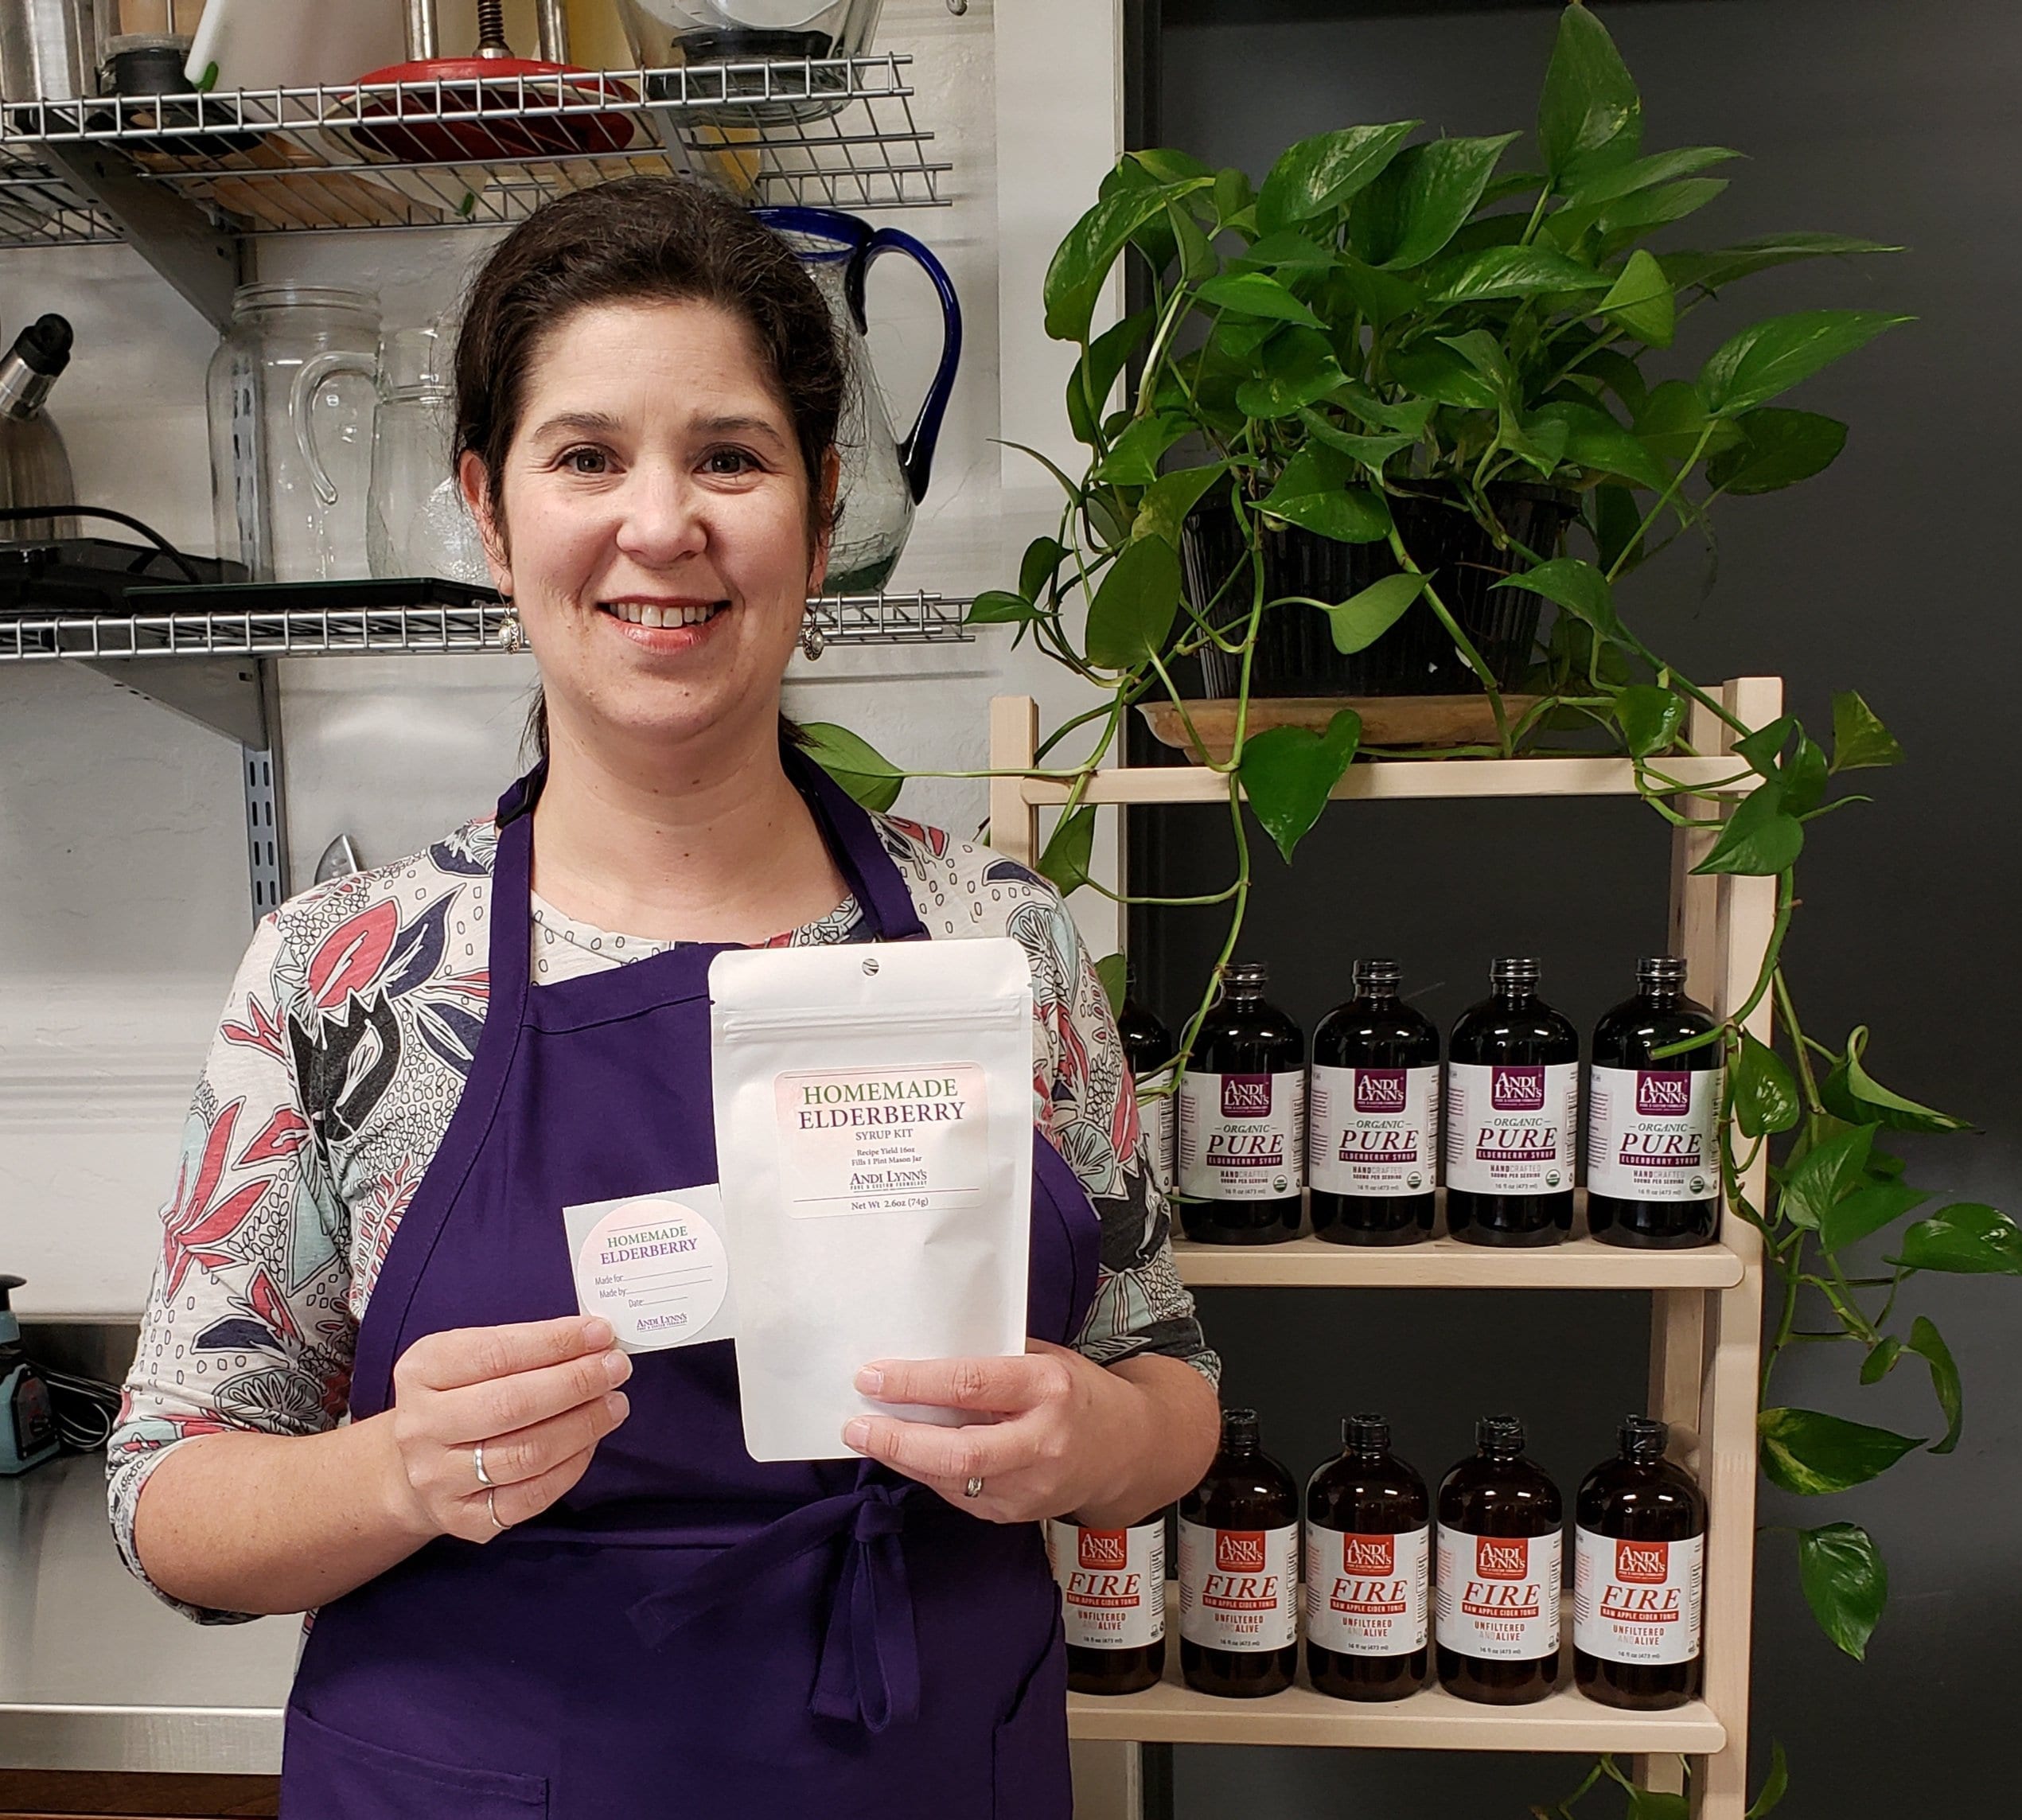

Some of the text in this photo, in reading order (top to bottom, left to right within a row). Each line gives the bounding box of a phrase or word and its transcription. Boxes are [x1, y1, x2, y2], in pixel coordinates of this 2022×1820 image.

[1226, 1080, 1264, 1095] ANDI
[1359, 1075, 1398, 1090] ANDI
[1498, 1072, 1537, 1088] ANDI
[1642, 1077, 1682, 1093] ANDI
[802, 1078, 958, 1105] HOMEMADE
[798, 1101, 965, 1130] ELDERBERRY
[855, 1128, 914, 1141] SYRUP KIT
[1223, 1124, 1270, 1133] ORGANIC
[1638, 1123, 1688, 1132] ORGANIC
[1206, 1134, 1284, 1154] PURE
[1338, 1130, 1419, 1150] PURE
[1476, 1128, 1557, 1148] PURE
[1619, 1133, 1703, 1153] PURE
[857, 1148, 879, 1157] Recipe
[881, 1147, 898, 1156] Yield
[889, 1156, 910, 1164] Mason
[1622, 1156, 1671, 1164] ELDERBERRY
[849, 1172, 883, 1186] ANDI
[851, 1197, 929, 1210] Net Wt 2.6oz (74g)
[607, 1226, 688, 1248] HOMEMADE
[600, 1238, 698, 1265] ELDERBERRY
[595, 1275, 613, 1285] Made
[599, 1289, 617, 1299] Made
[637, 1318, 659, 1327] ANDI
[1082, 1534, 1119, 1549] ANDI
[1221, 1535, 1256, 1551] ANDI
[1349, 1539, 1385, 1555] ANDI
[1482, 1542, 1520, 1558] ANDI
[1622, 1545, 1659, 1561] ANDI
[1066, 1572, 1141, 1596] FIRE
[1202, 1574, 1279, 1598] FIRE
[1330, 1577, 1408, 1603] FIRE
[1081, 1596, 1100, 1605] APPLE
[1120, 1597, 1138, 1606] TONIC
[1463, 1581, 1541, 1606] FIRE
[1601, 1584, 1681, 1610] FIRE
[1078, 1610, 1126, 1621] UNFILTERED
[1346, 1604, 1365, 1612] APPLE
[1479, 1607, 1498, 1615] APPLE
[1617, 1611, 1636, 1619] APPLE
[1214, 1613, 1264, 1623] UNFILTERED
[1342, 1617, 1392, 1628] UNFILTERED
[1475, 1621, 1525, 1632] UNFILTERED
[1613, 1624, 1664, 1636] UNFILTERED
